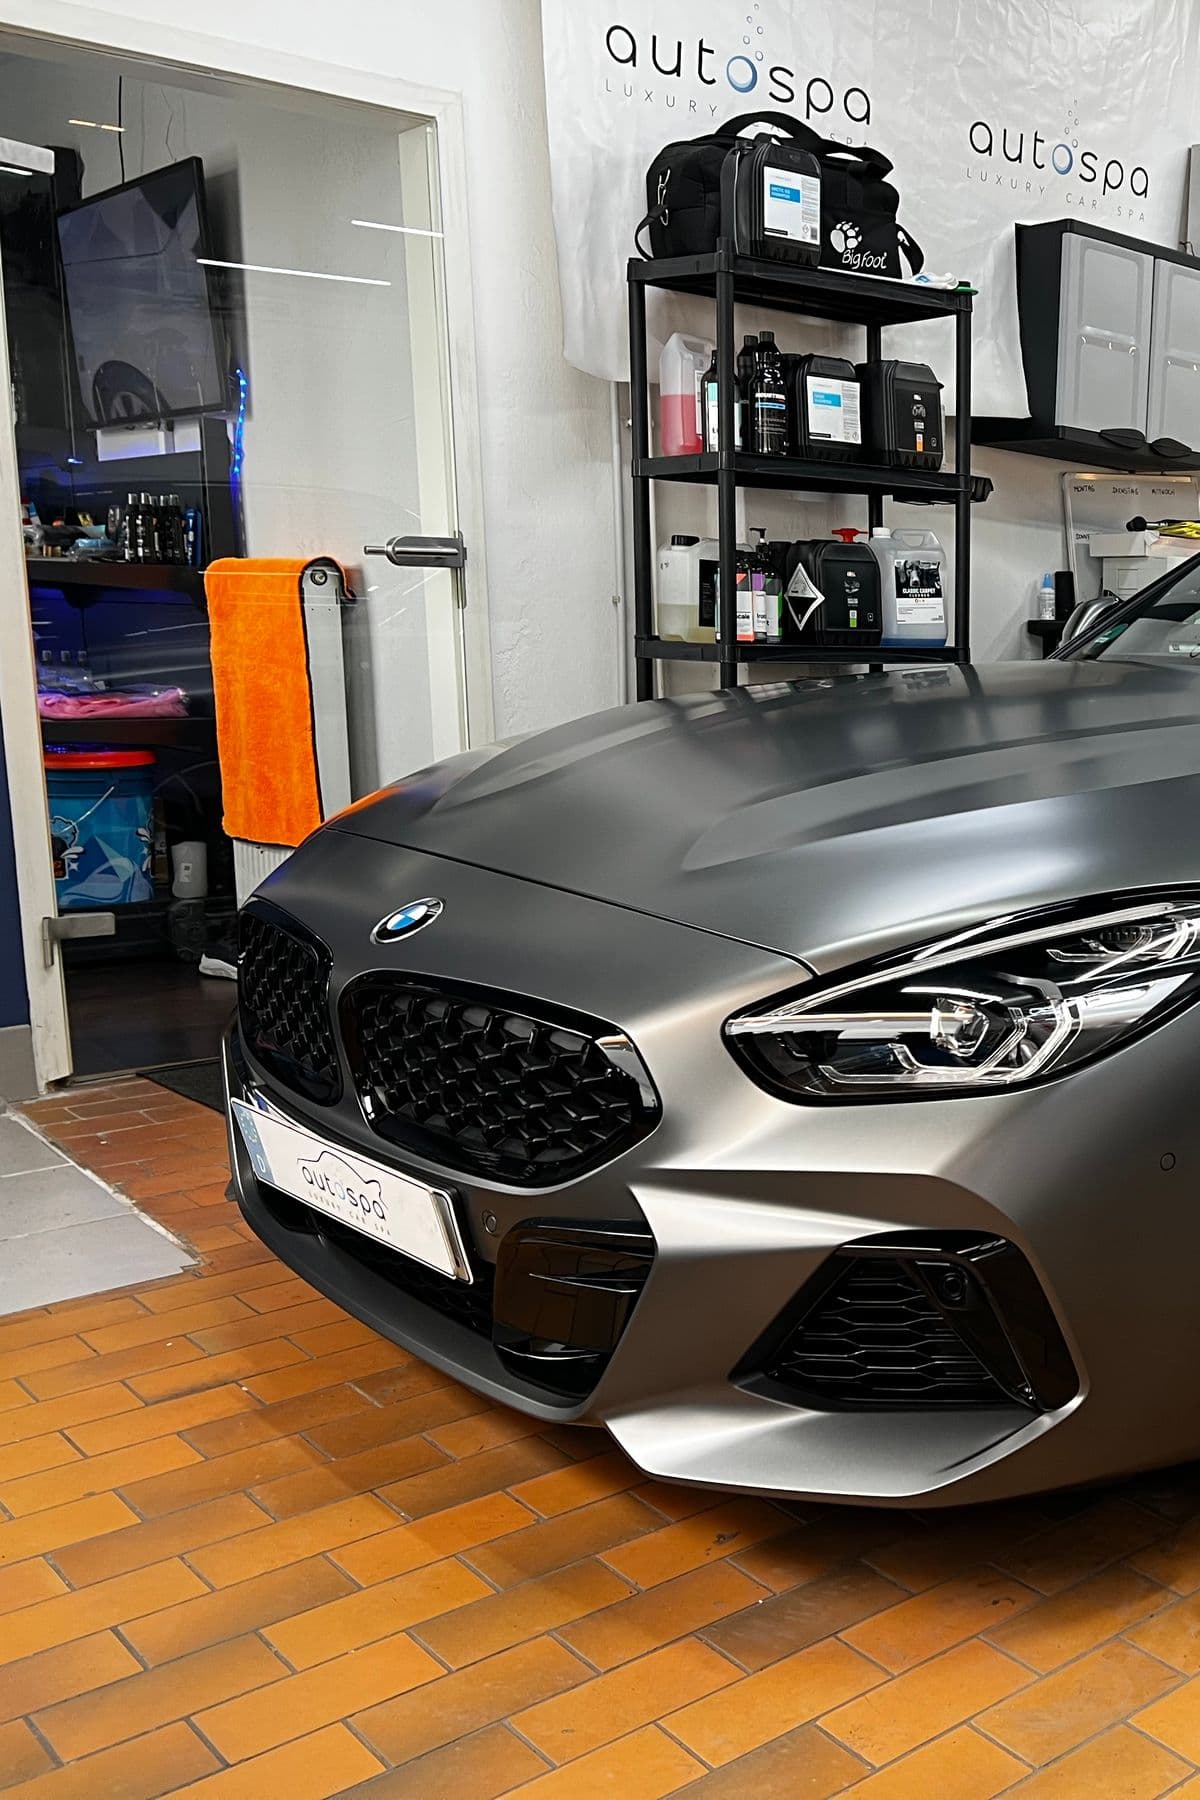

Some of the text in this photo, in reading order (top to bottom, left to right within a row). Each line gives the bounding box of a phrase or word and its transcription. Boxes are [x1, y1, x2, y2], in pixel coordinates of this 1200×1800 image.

[605, 78, 717, 117] LUXURY
[606, 24, 871, 126] autospa
[969, 121, 1150, 199] autospa
[966, 167, 1146, 223] LUXURY CAR SPA
[301, 1165, 387, 1222] autospa
